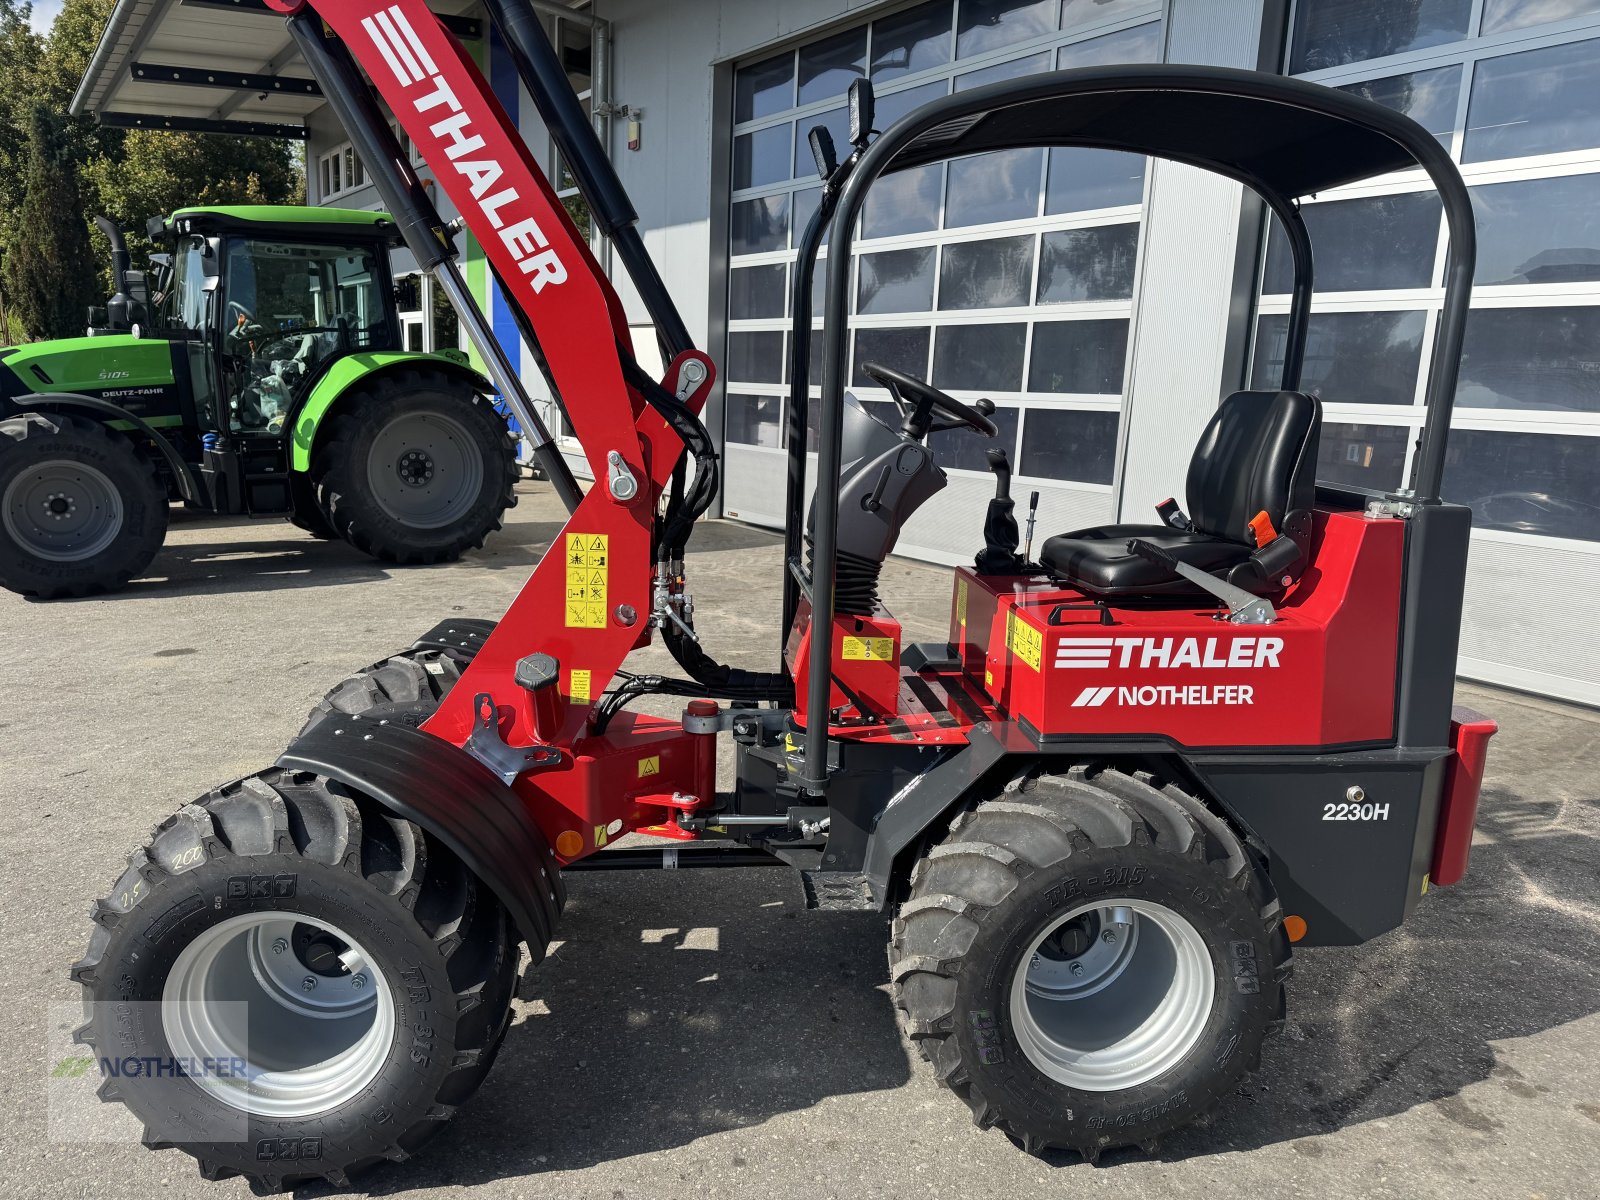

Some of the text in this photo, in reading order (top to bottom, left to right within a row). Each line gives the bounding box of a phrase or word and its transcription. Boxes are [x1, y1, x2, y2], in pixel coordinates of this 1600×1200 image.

[413, 75, 568, 295] THALER
[99, 371, 130, 380] 5105
[102, 387, 164, 398] DEUTZ-FAHR
[1114, 637, 1284, 668] THALER
[1117, 684, 1254, 706] NOTHELFER
[1322, 803, 1390, 821] 2230H
[228, 876, 296, 899] BKT
[257, 1139, 322, 1161] BKT
